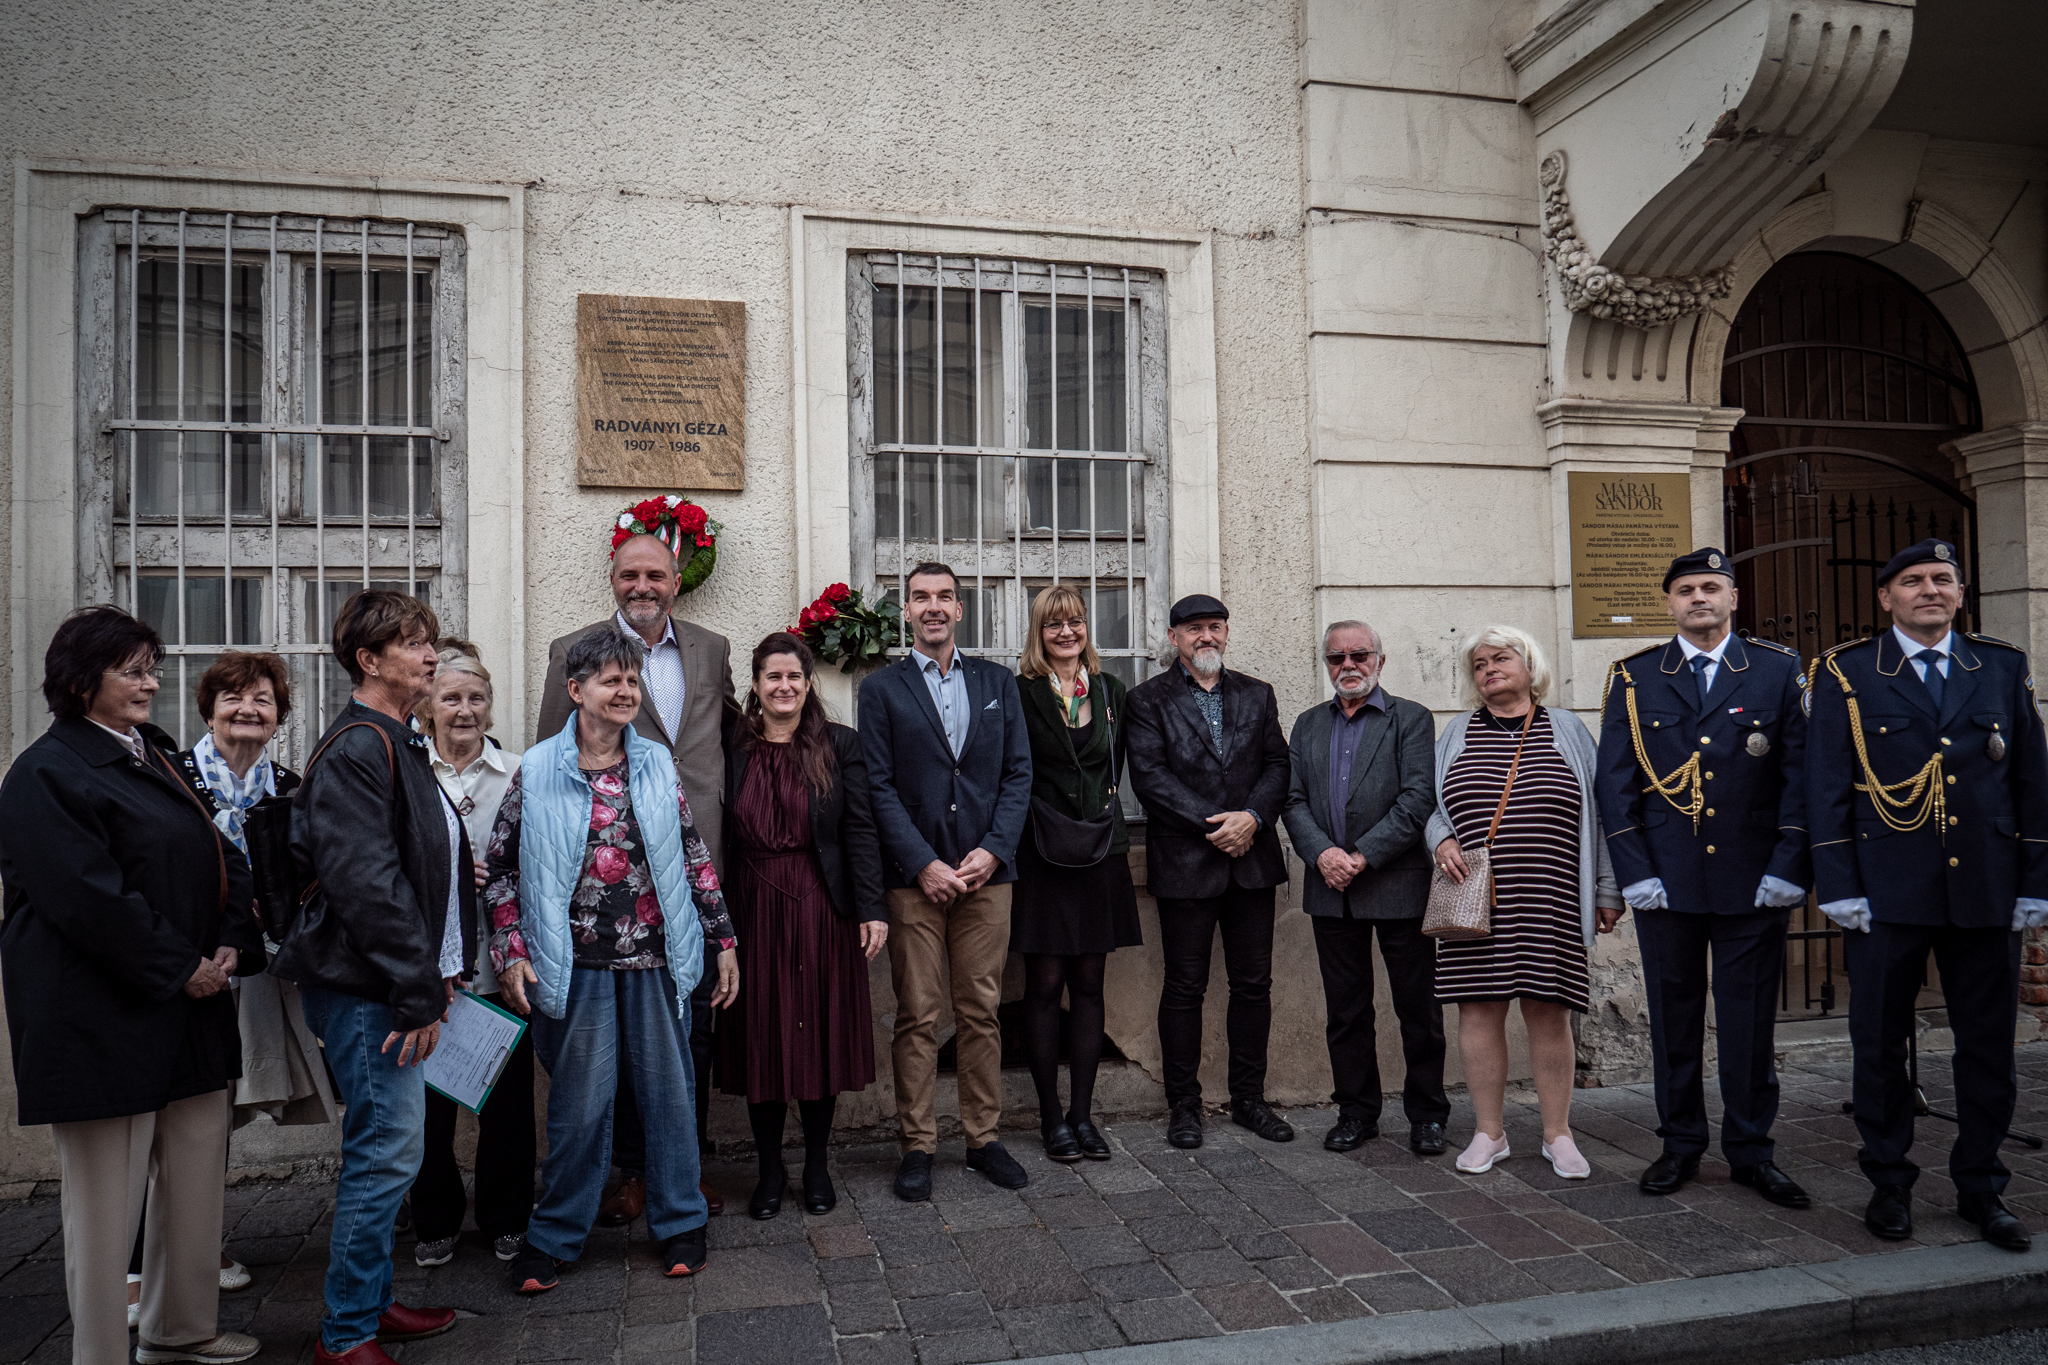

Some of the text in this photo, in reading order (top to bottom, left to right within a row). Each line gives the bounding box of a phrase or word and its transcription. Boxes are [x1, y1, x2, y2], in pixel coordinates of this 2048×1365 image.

[594, 419, 728, 436] RADVÁNYI GÉZA
[624, 440, 656, 451] 1907
[670, 442, 701, 452] 1986
[1601, 479, 1656, 498] MÁRAI
[1596, 493, 1663, 510] SÁNDOR
